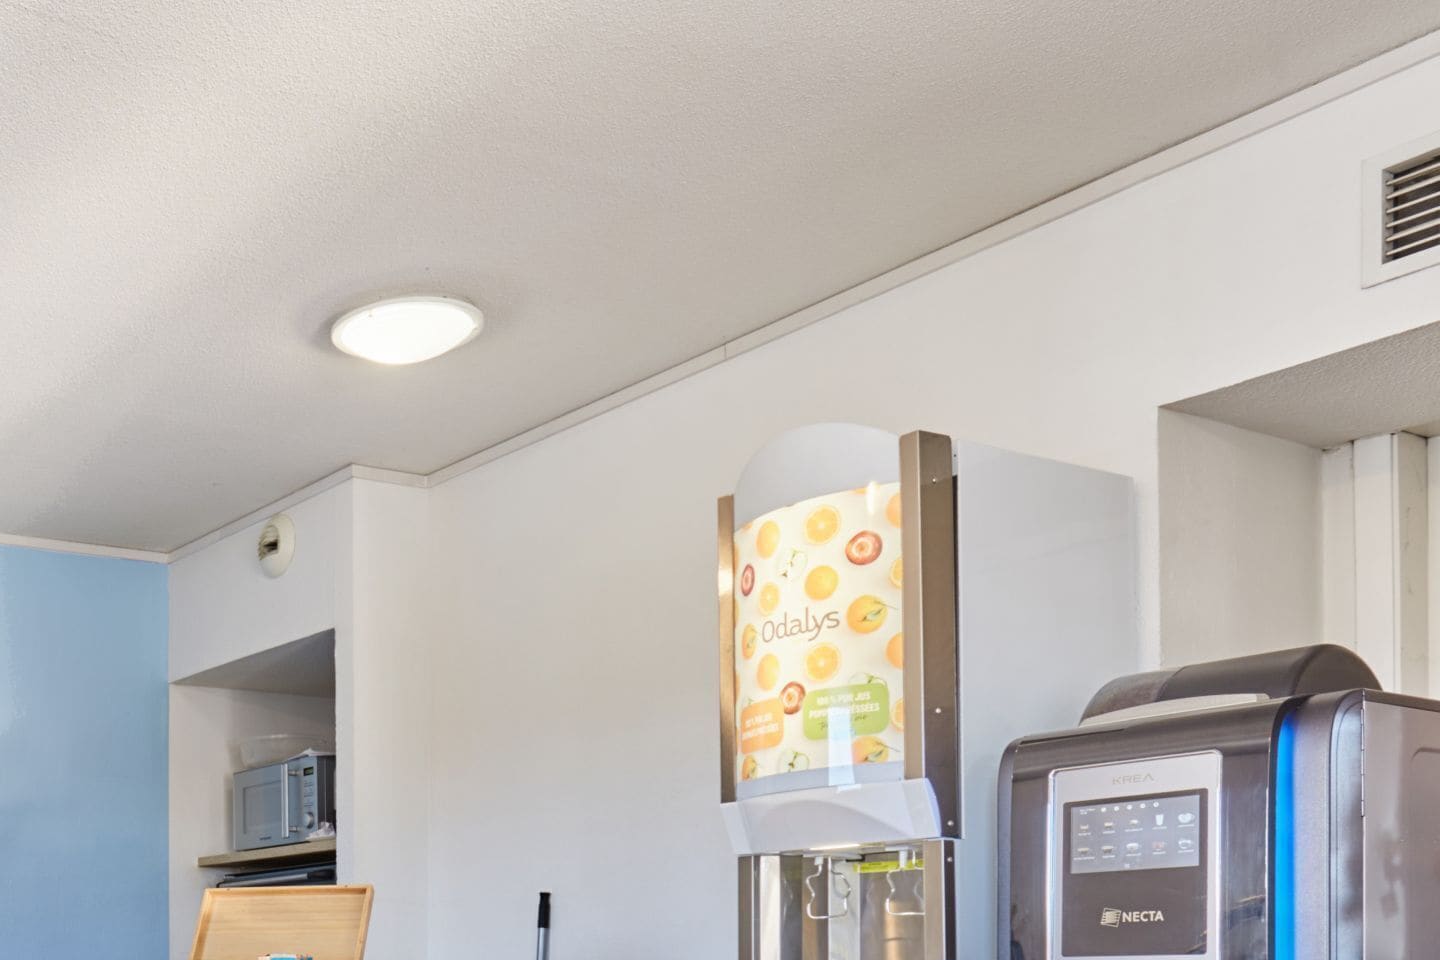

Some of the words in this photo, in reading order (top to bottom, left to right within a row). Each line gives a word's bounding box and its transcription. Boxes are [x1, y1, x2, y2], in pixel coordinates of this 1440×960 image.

[761, 606, 841, 643] Odalys
[1112, 773, 1155, 785] KREA
[1122, 910, 1165, 923] NECTA
